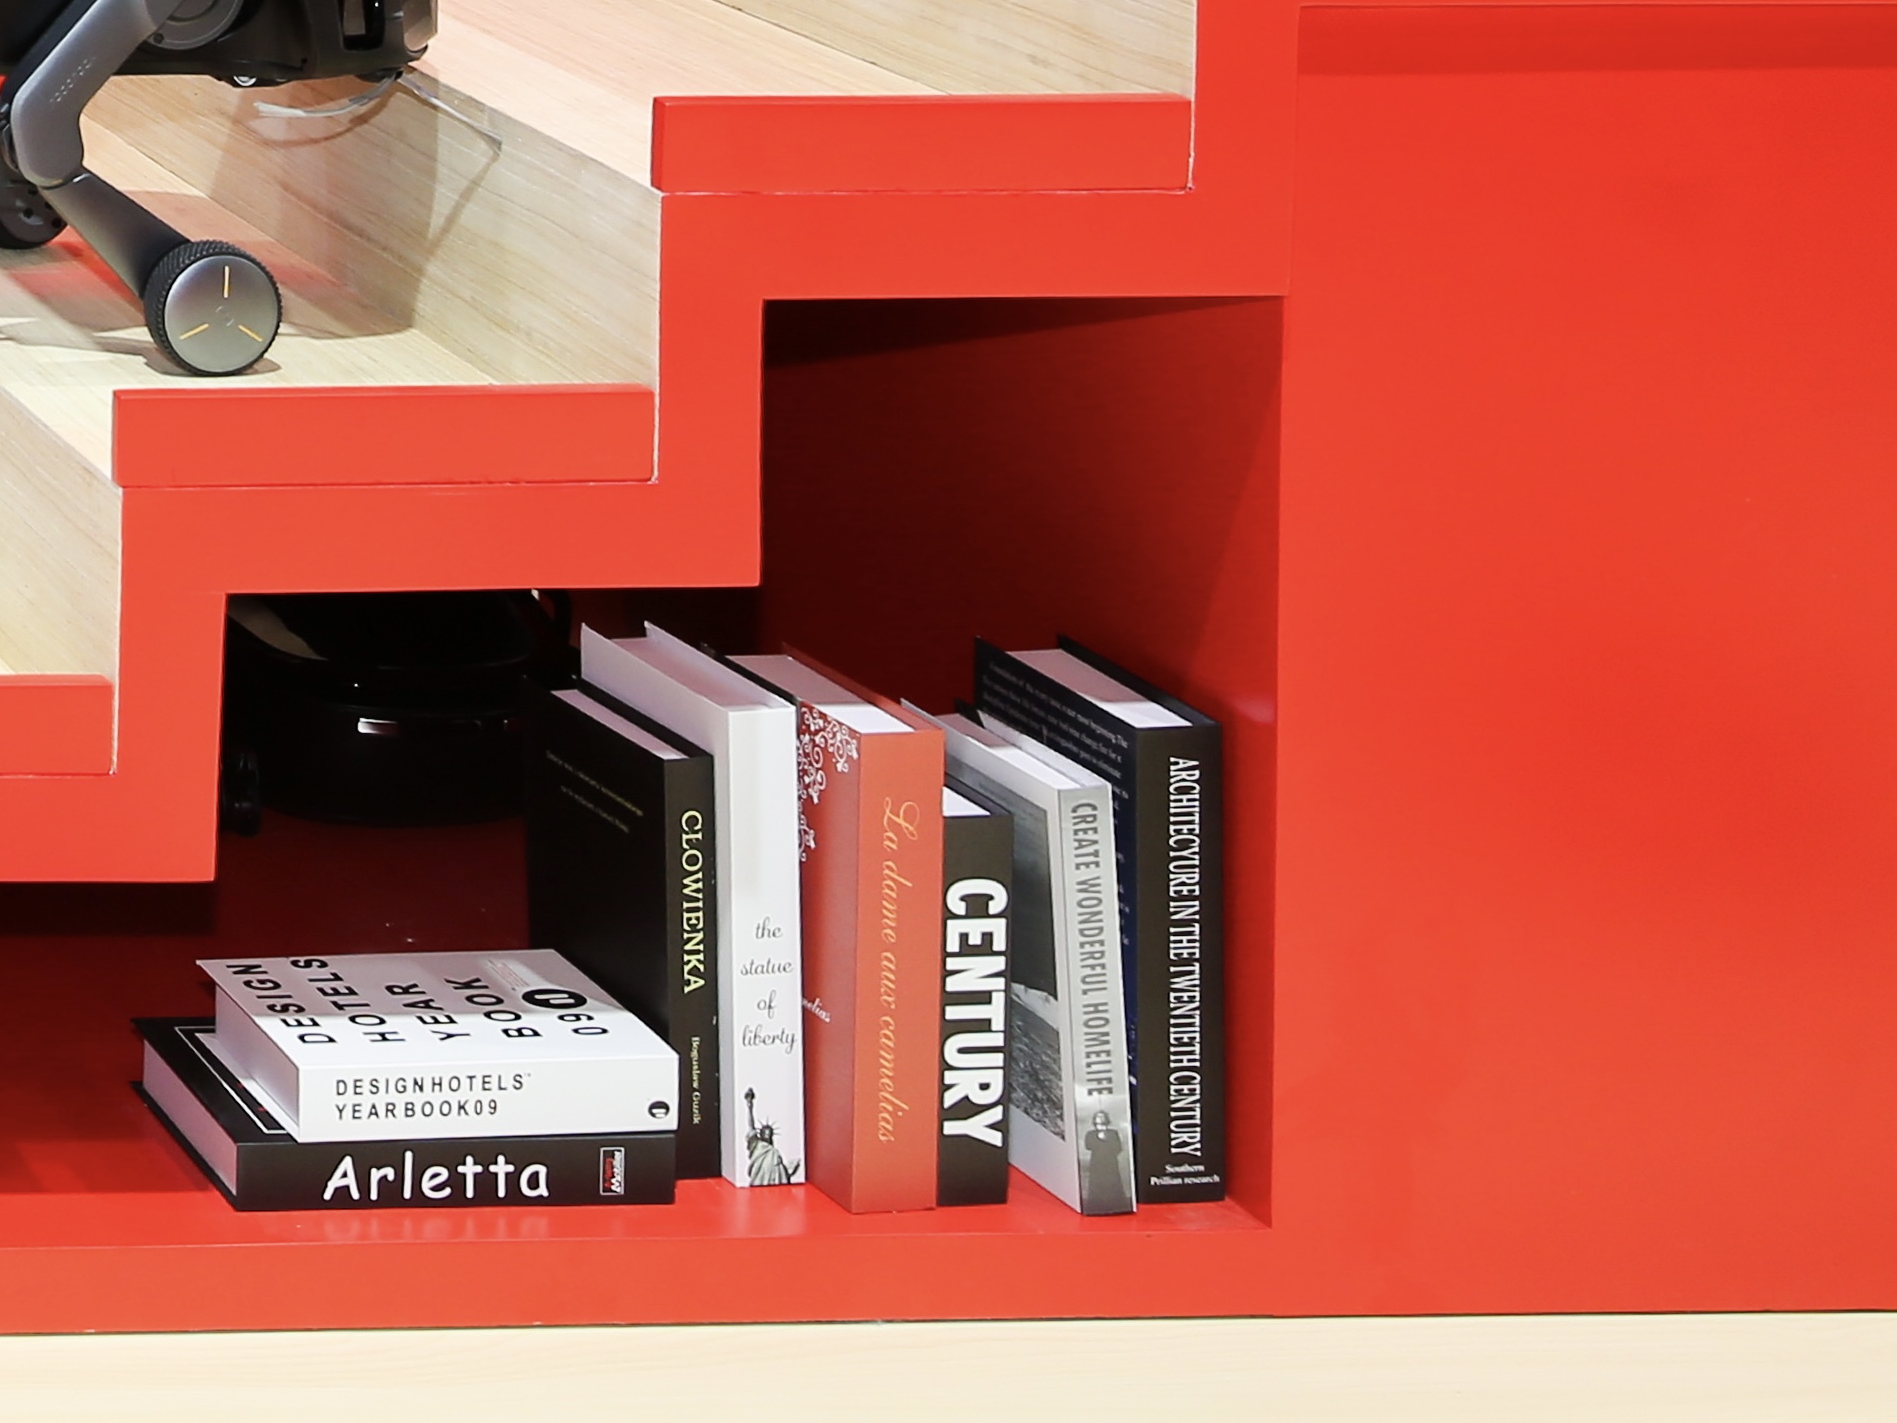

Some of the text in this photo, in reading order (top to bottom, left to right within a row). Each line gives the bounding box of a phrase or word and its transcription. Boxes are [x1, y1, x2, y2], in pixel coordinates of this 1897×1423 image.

[755, 917, 783, 939] the
[1168, 900, 1201, 920] IN
[740, 958, 794, 976] statue
[1070, 802, 1114, 1097] CREATE WONDERFUL HOMELIFE
[1168, 923, 1201, 960] THE
[877, 797, 920, 1143] La dame aux camelias
[226, 963, 337, 1045] DESIGN
[291, 957, 406, 1043] HOTELS
[385, 983, 472, 1041] YEAR
[443, 976, 543, 1039] BOOK
[557, 1012, 609, 1036] 09
[756, 990, 777, 1019] of
[942, 877, 1009, 1149] CENTURY
[1168, 962, 1202, 1068] TWENTIETH
[742, 1024, 796, 1055] liberty
[692, 1091, 701, 1125] Guzik
[1168, 1070, 1202, 1158] CENTURY
[323, 1150, 549, 1202] Arletta
